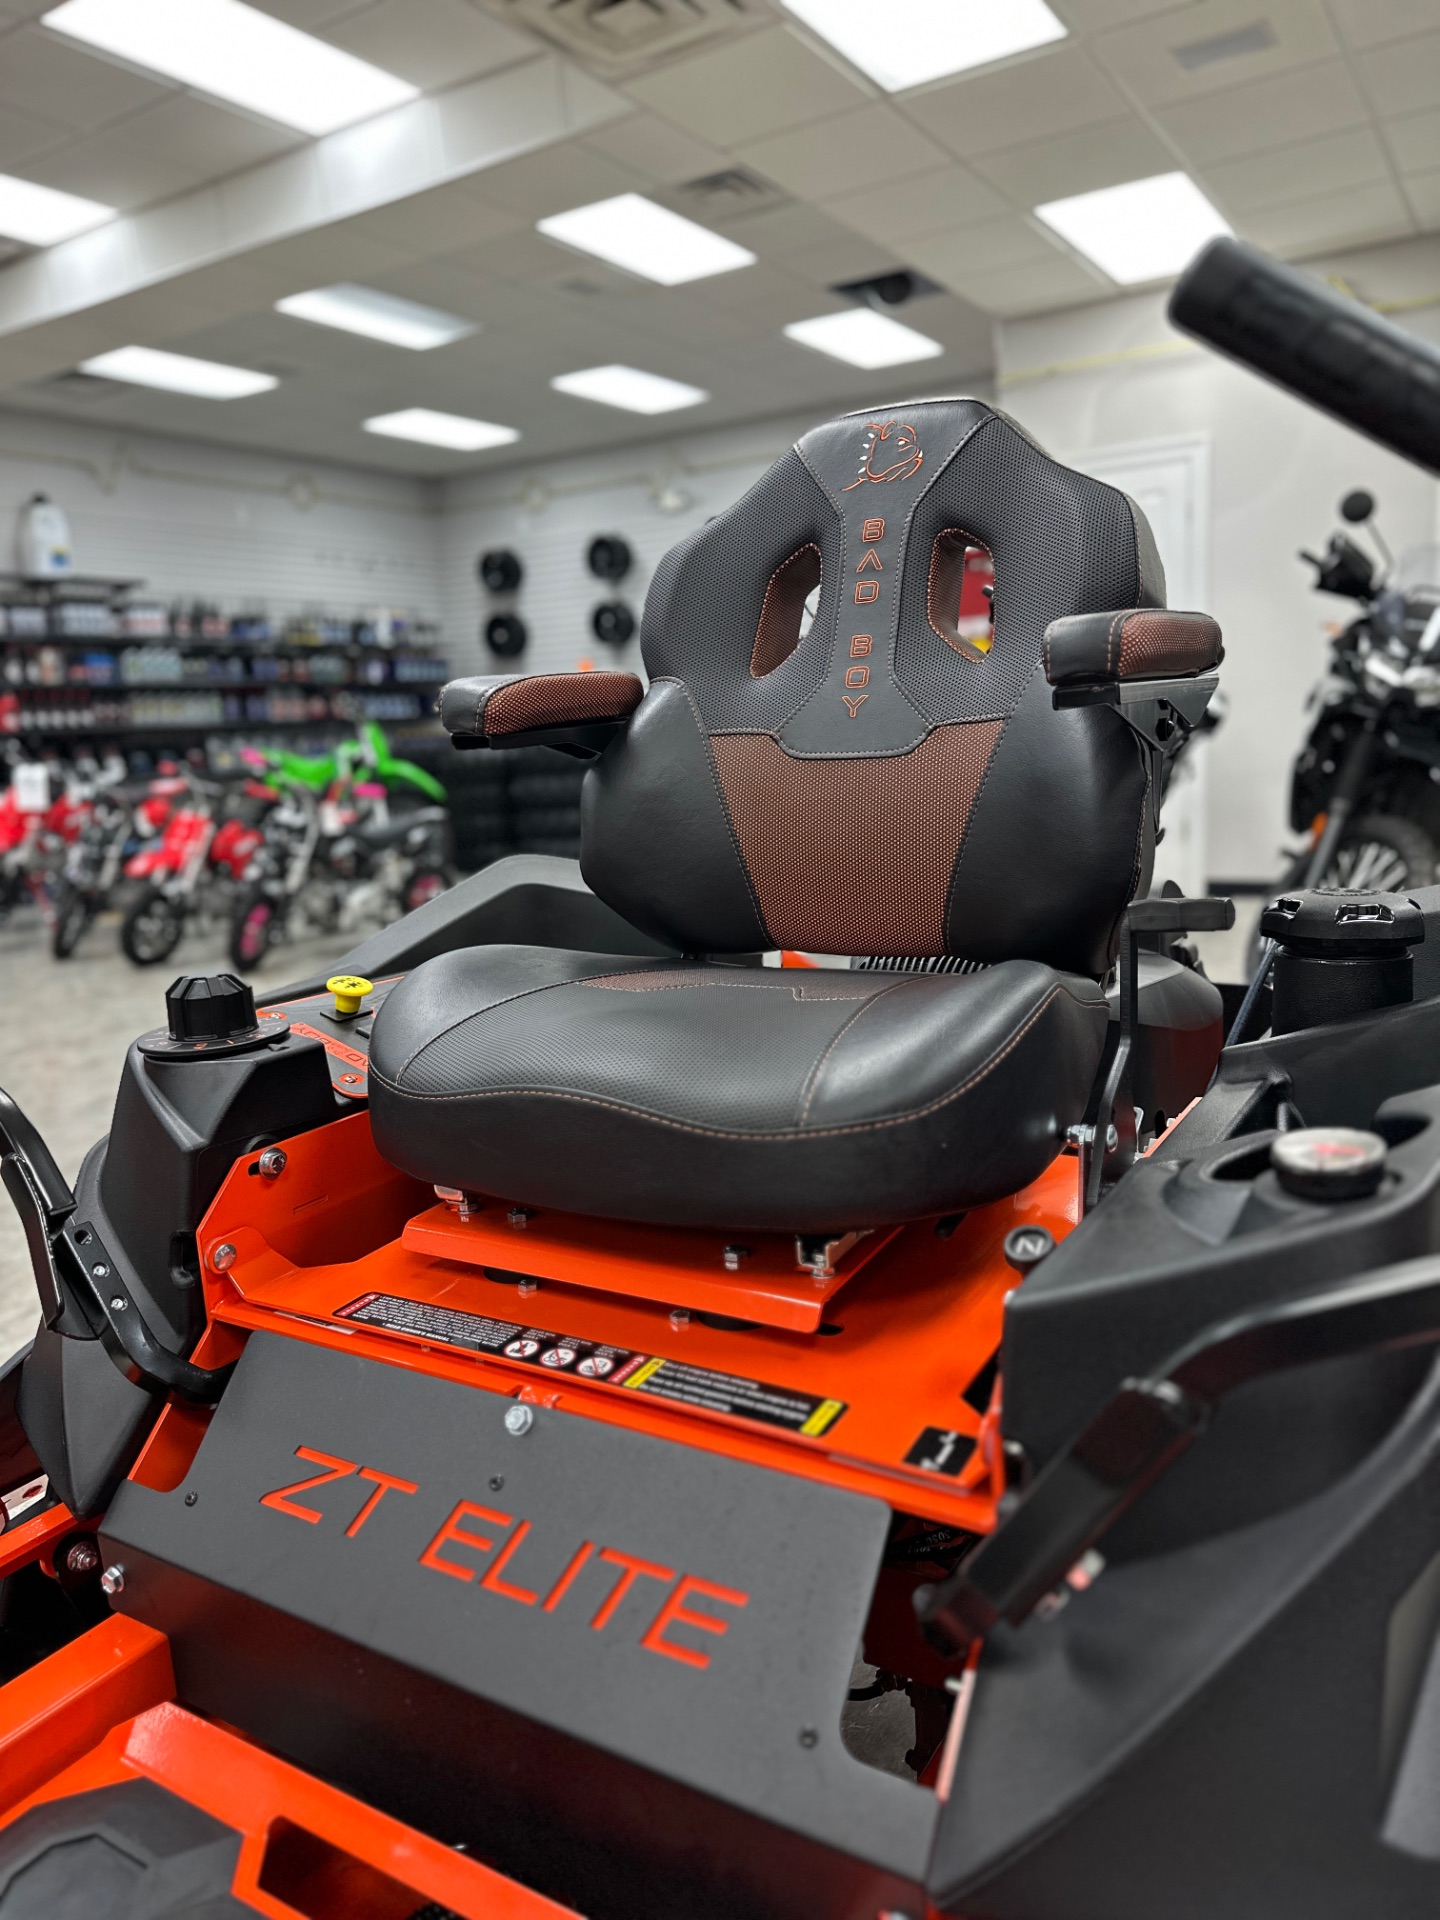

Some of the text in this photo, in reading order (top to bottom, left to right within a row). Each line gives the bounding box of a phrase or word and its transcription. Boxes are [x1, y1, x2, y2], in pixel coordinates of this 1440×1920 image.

[841, 518, 886, 718] BAD BOY
[259, 1444, 749, 1671] ZT ELITE
